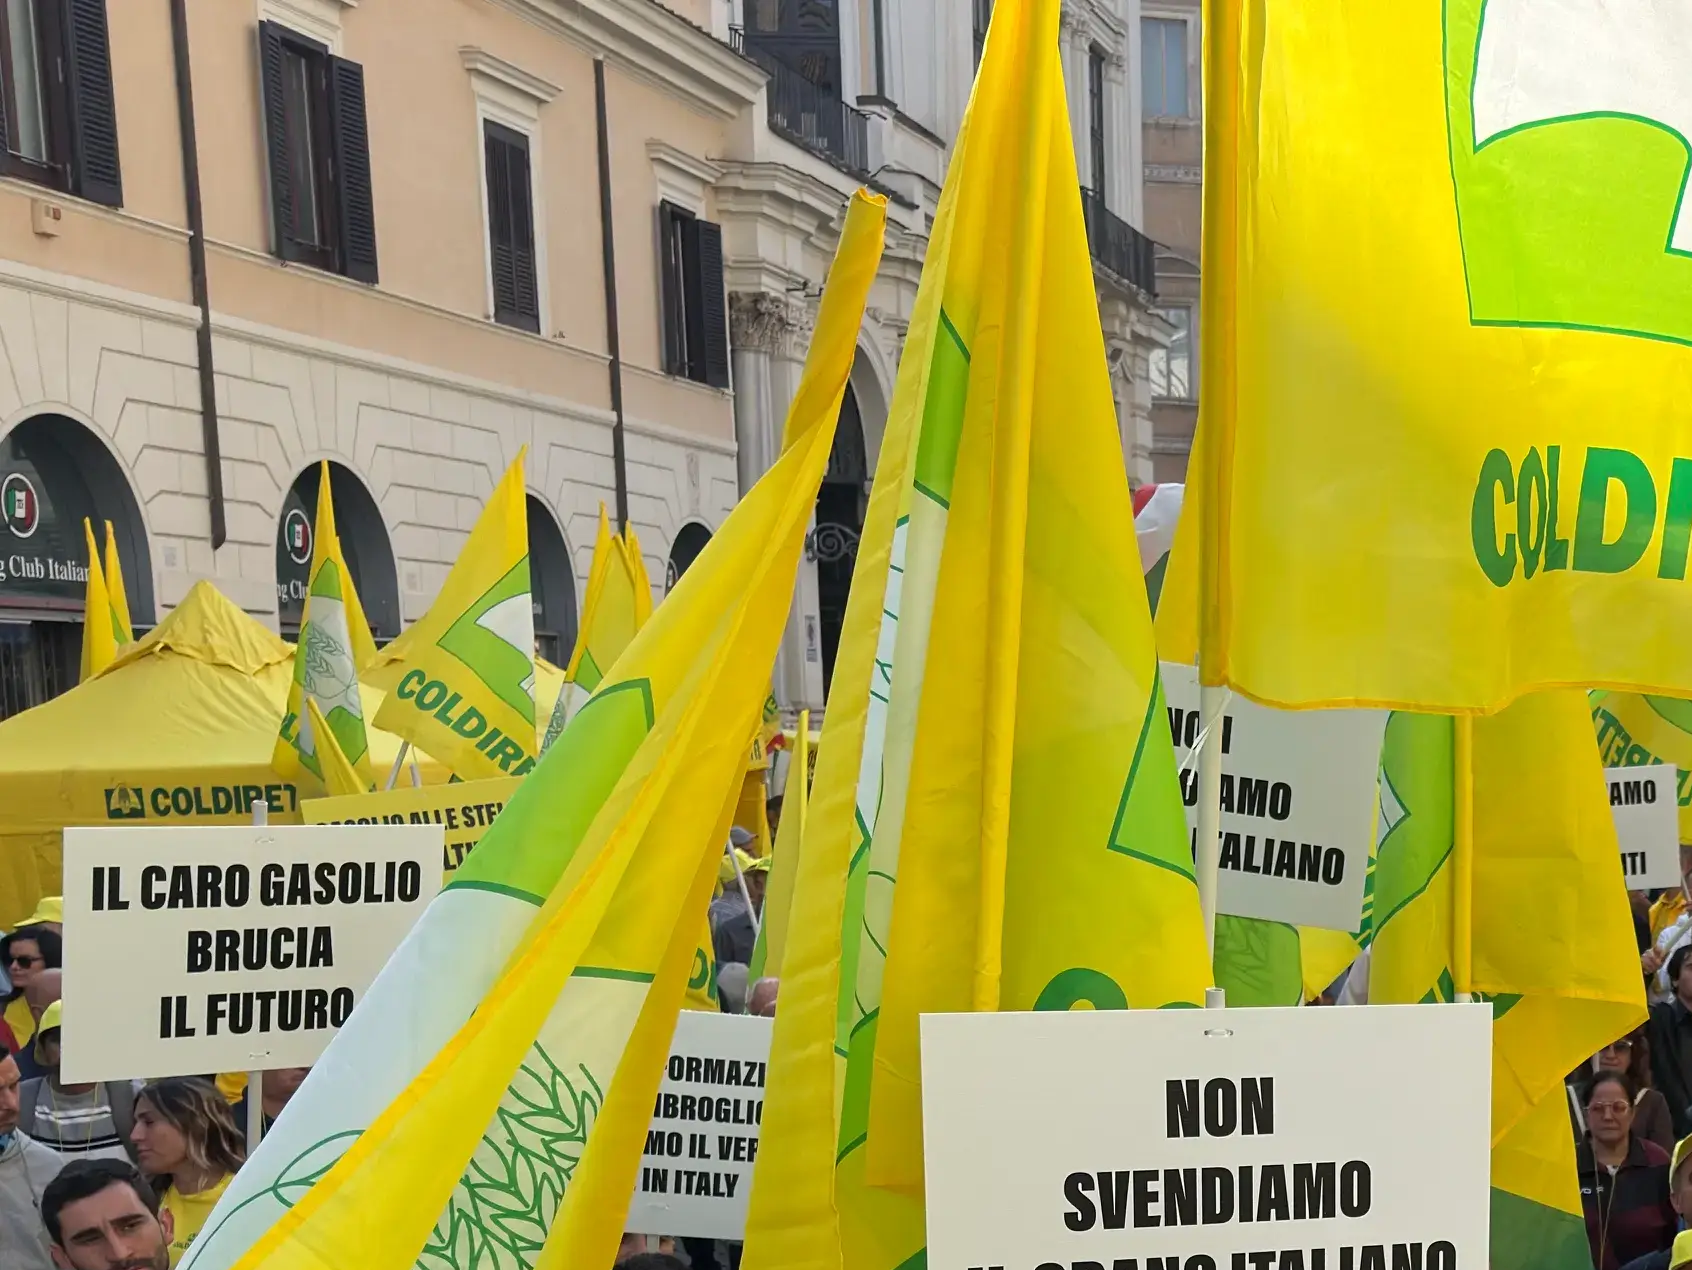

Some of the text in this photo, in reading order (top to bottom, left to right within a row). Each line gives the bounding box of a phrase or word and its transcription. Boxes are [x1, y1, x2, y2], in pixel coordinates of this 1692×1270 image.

[9, 554, 45, 579] Club
[92, 861, 421, 911] IL CARO GASOLIO
[187, 926, 334, 973] BRUCIA
[160, 987, 354, 1038] IL FUTURO
[1166, 1077, 1274, 1138] NON
[689, 1134, 711, 1159] IL
[642, 1167, 739, 1198] IN ITALY
[1064, 1161, 1371, 1232] SVENDIAMO
